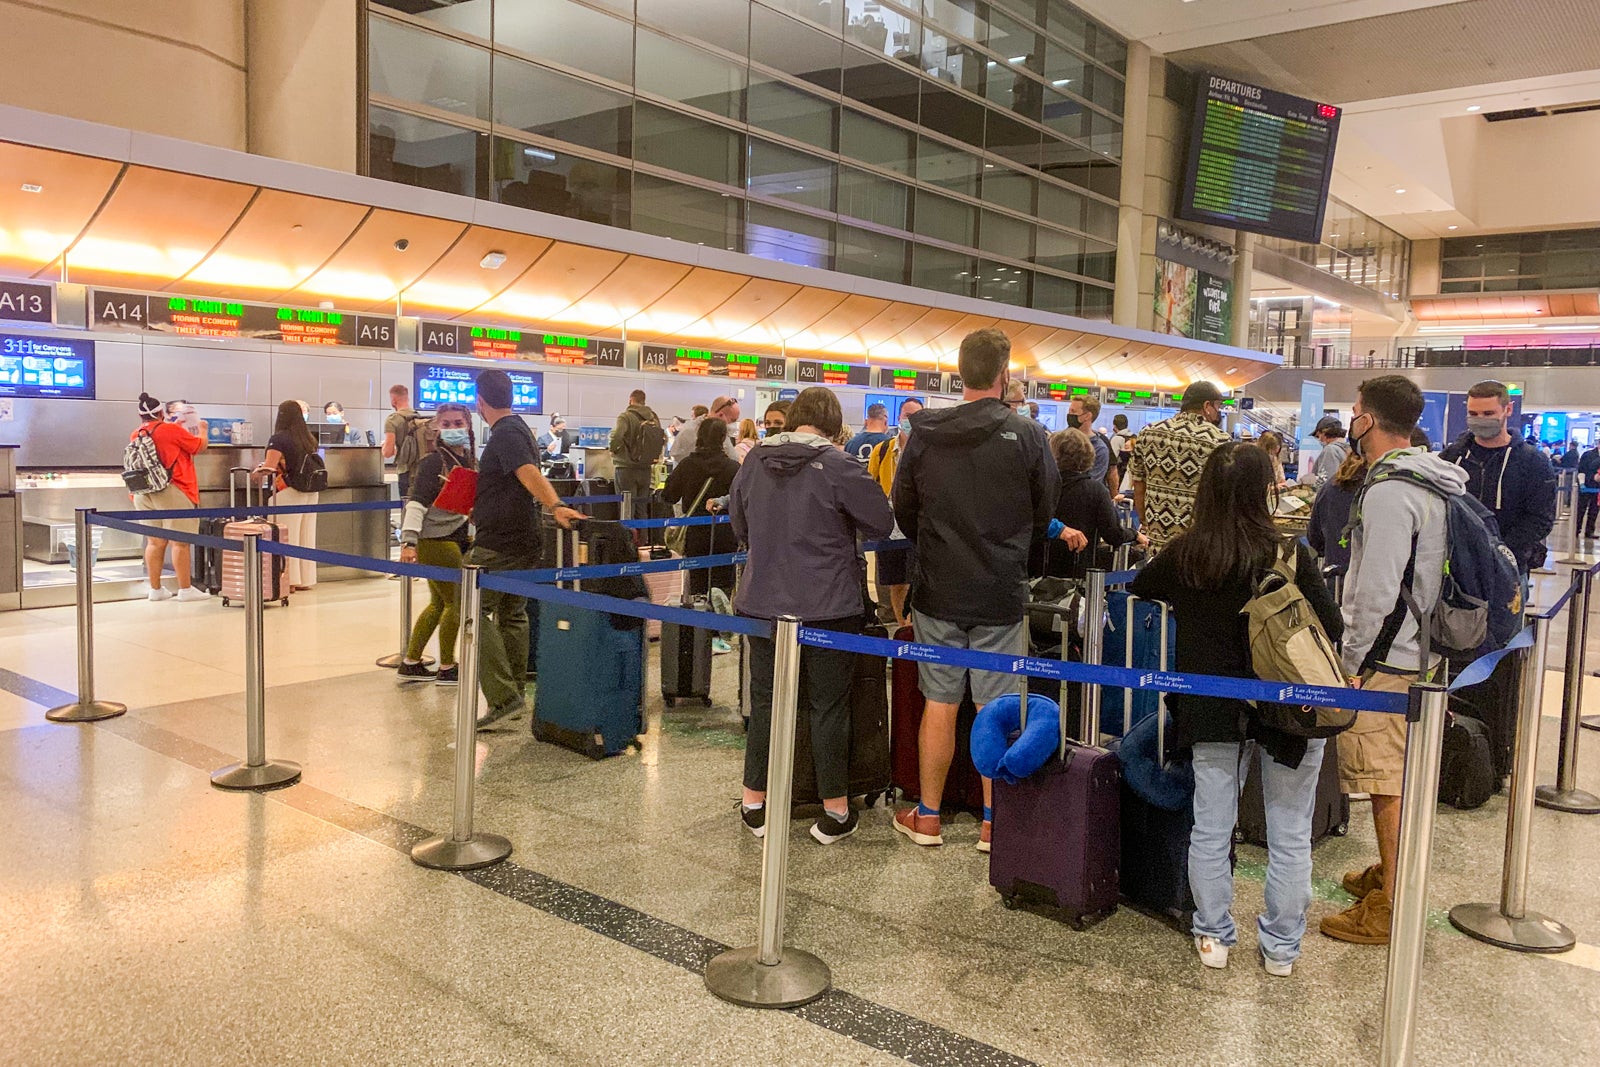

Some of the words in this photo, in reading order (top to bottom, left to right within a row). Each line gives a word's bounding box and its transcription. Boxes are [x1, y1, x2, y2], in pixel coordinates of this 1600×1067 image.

[1209, 76, 1262, 100] DEPARTURES
[0, 292, 43, 313] A13
[102, 302, 142, 321] A14
[202, 317, 239, 328] ECONOMY
[305, 325, 338, 336] ECONOMY
[361, 324, 389, 341] A15
[427, 331, 454, 347] A16
[4, 338, 34, 354] 3-1-1
[600, 348, 620, 361] A17
[645, 352, 665, 365] A18
[767, 364, 783, 375] A19
[801, 367, 815, 378] A20
[929, 377, 940, 387] A21
[951, 379, 963, 389] A22
[1035, 660, 1053, 668] Angeles
[1040, 667, 1060, 675] Airports
[1171, 681, 1192, 689] Airports
[1313, 695, 1336, 703] Airports
